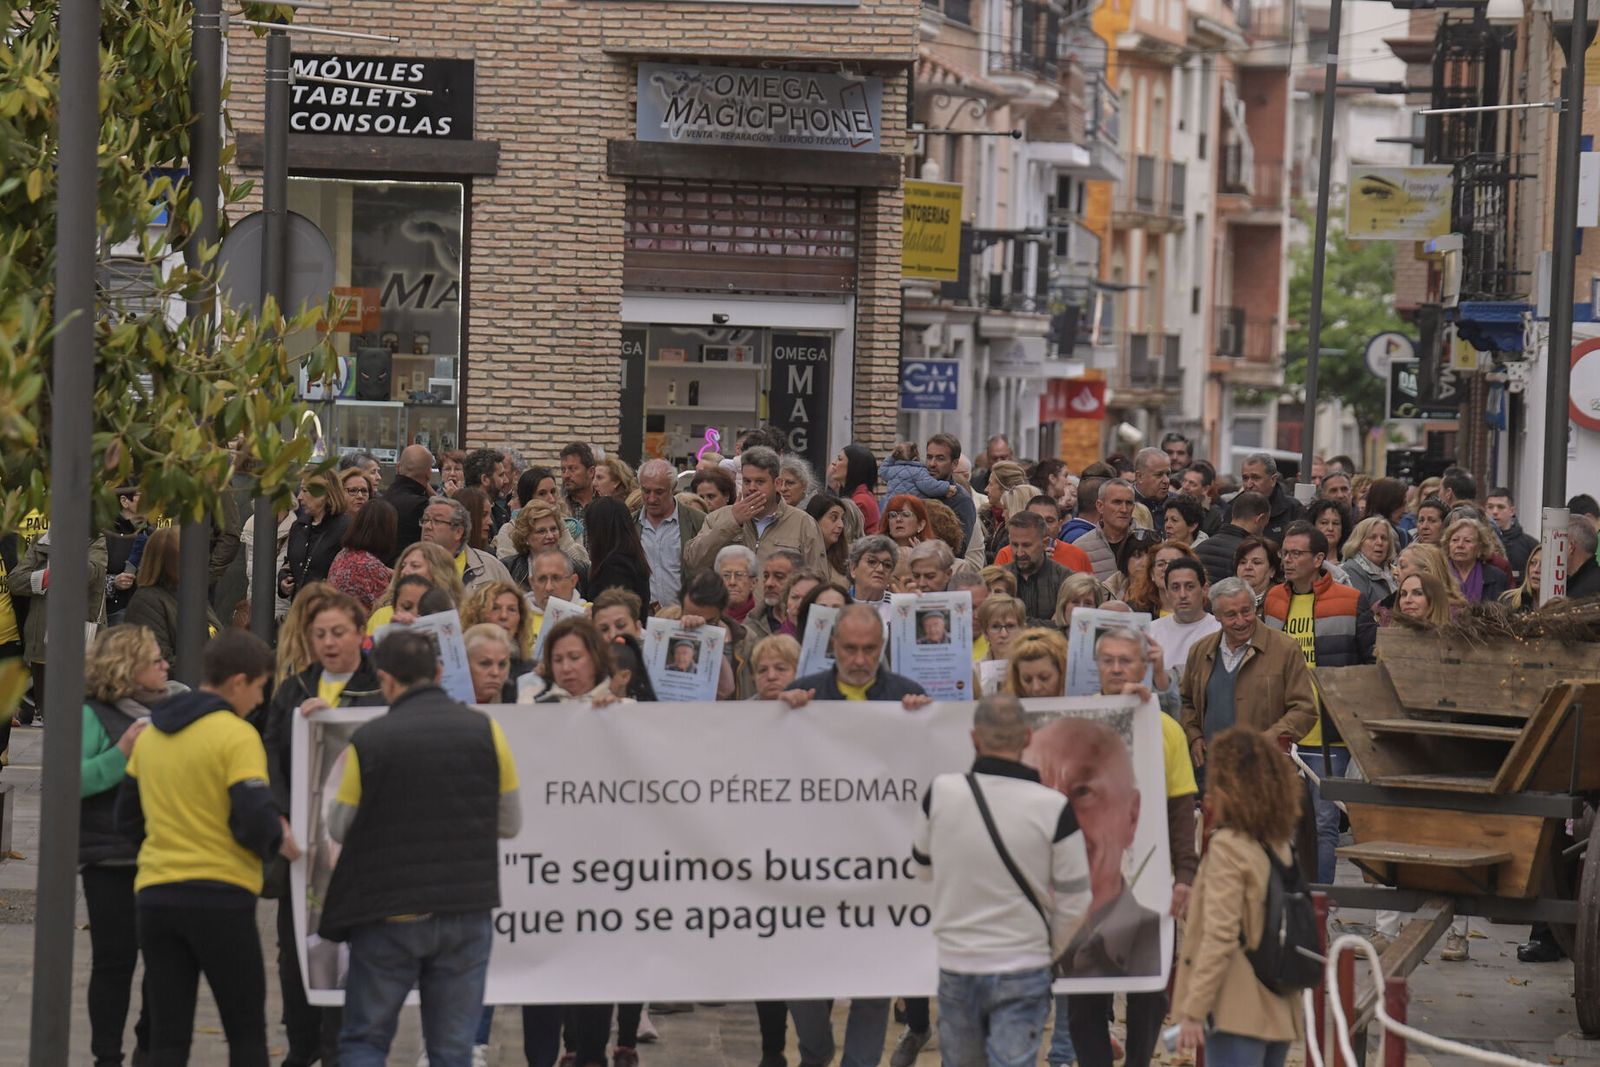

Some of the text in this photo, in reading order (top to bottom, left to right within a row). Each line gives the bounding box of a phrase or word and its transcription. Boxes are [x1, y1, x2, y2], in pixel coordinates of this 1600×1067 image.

[293, 57, 424, 82] MÓVILES
[292, 85, 417, 108] TABLETS
[714, 74, 826, 101] OMEGA
[290, 111, 453, 135] CONSOLAS
[686, 130, 713, 139] VENTA
[778, 135, 813, 144] SERVICIO
[380, 272, 460, 309] MA
[621, 341, 643, 356] GA
[774, 346, 828, 362] OMEGA
[1398, 371, 1418, 391] DA
[545, 774, 918, 805] FRANCISCO PÉREZ BEDMAR
[505, 852, 560, 884] "Te
[572, 849, 753, 891] seguimos
[494, 900, 932, 943] que no se apague tu vo
